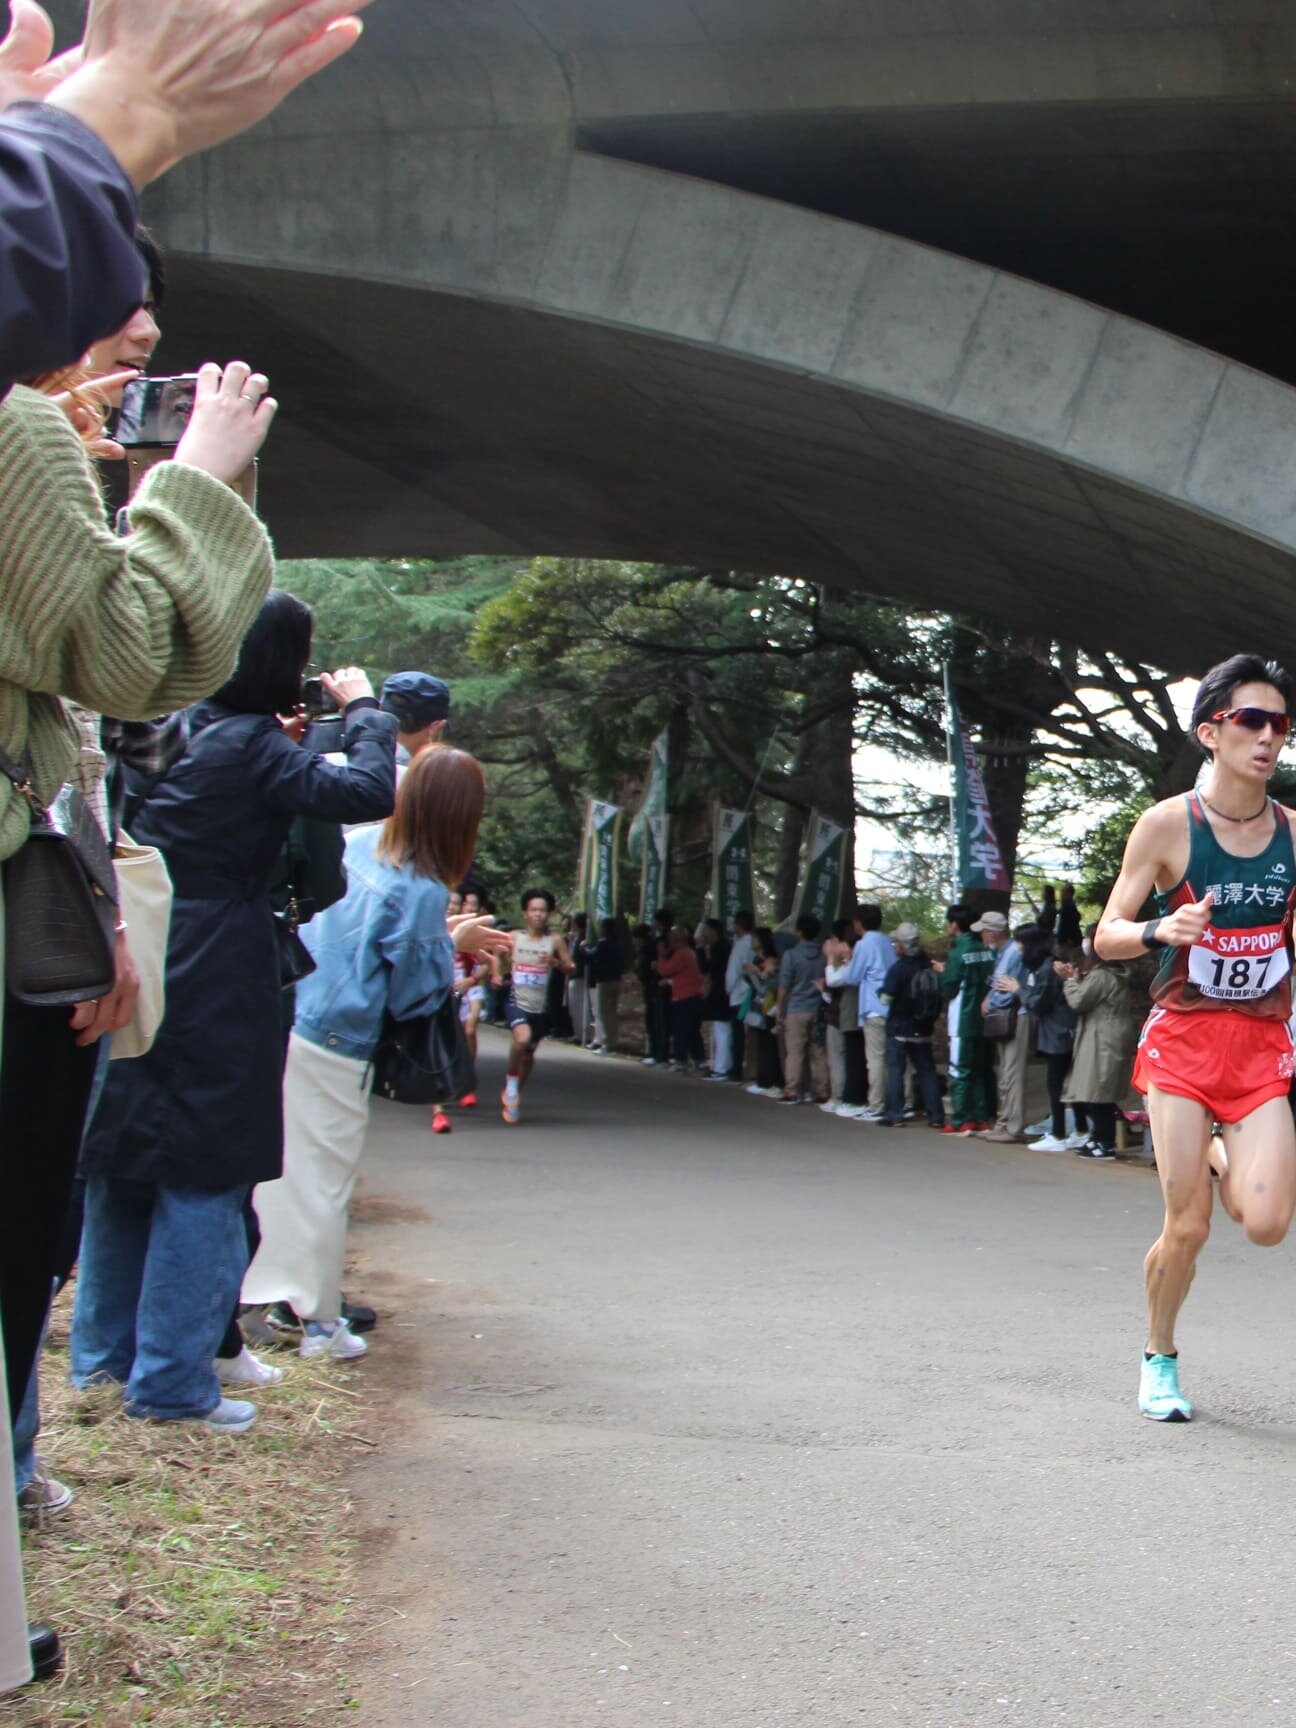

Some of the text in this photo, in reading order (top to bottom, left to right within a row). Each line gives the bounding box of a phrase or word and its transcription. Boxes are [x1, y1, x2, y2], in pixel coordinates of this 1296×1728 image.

[1205, 882, 1284, 907] 麗澤大学
[1211, 956, 1272, 988] 187
